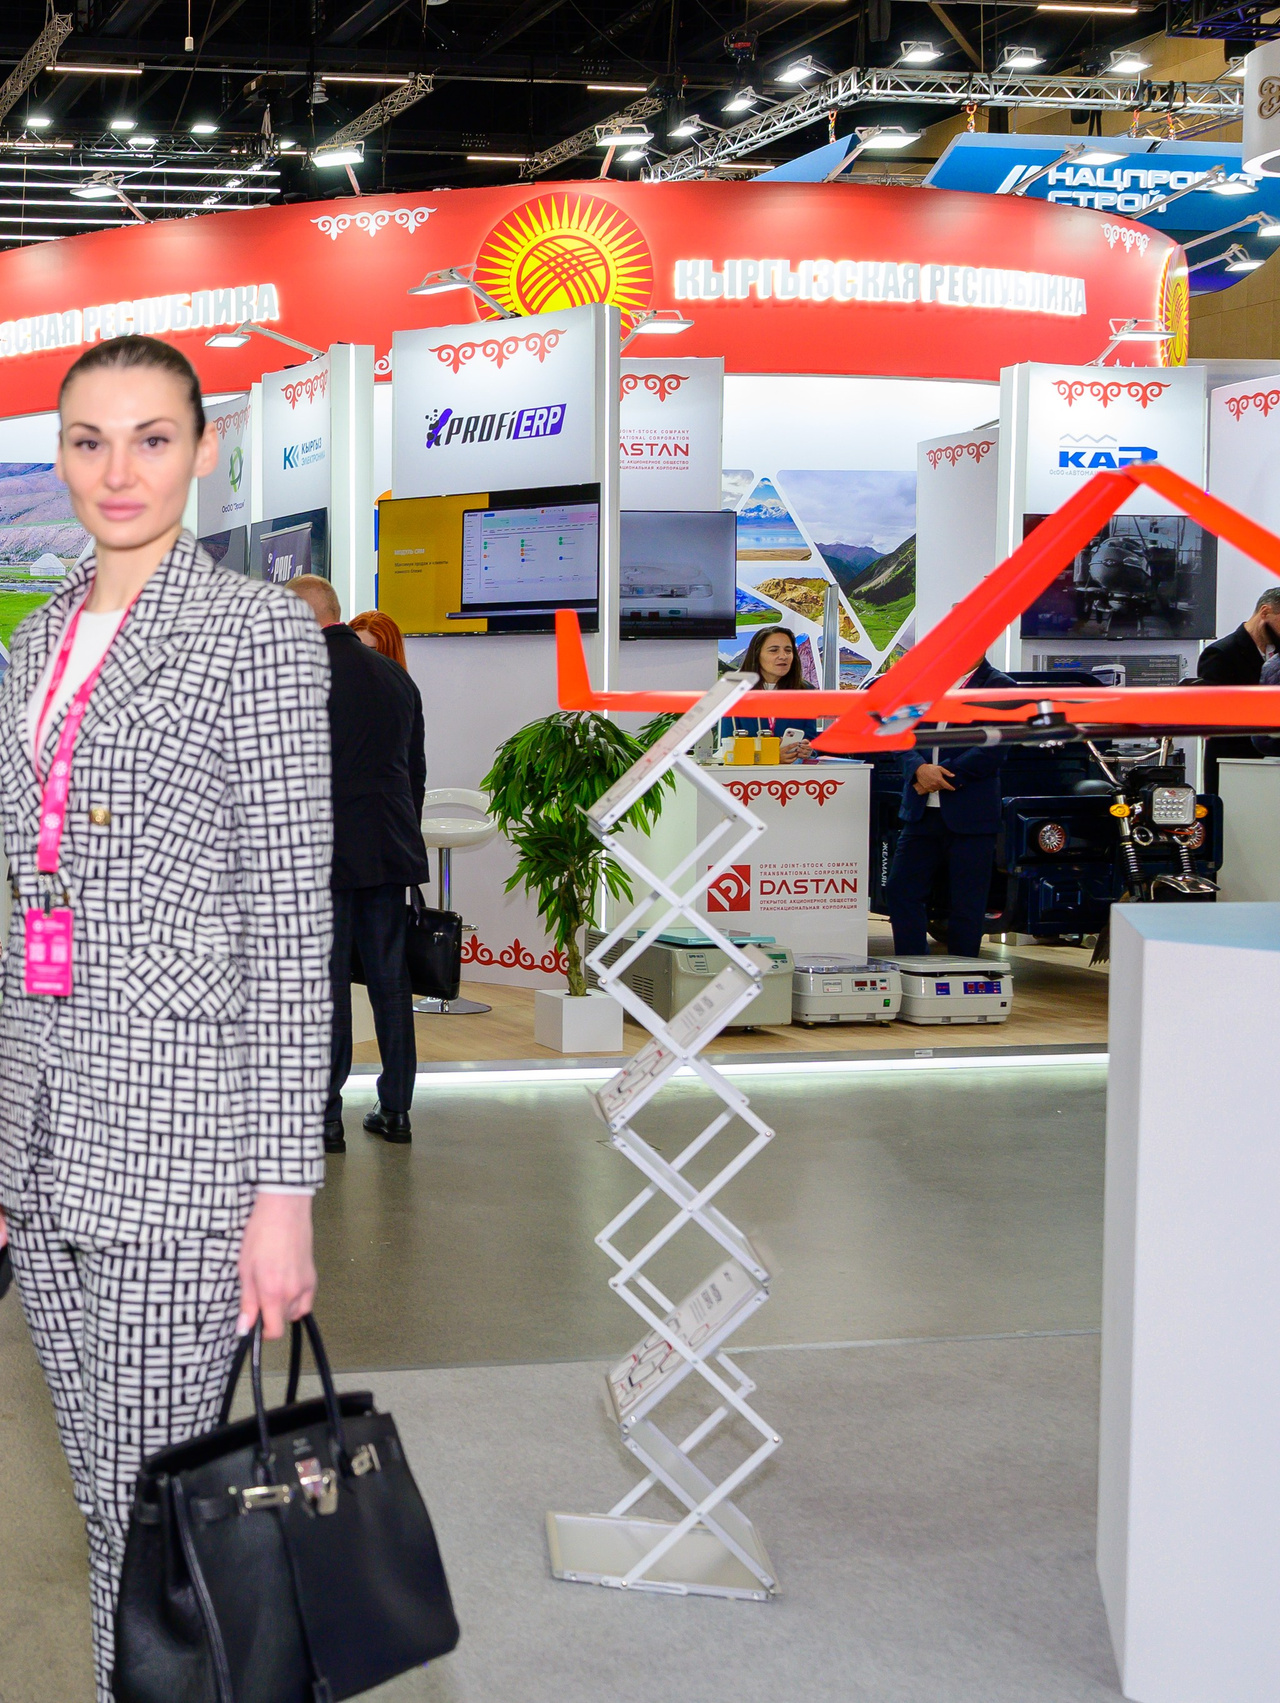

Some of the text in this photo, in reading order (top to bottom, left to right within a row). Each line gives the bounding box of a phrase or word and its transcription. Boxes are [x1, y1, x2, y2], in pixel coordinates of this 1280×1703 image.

[1047, 166, 1263, 193] НАЦПРОТ
[674, 259, 1087, 316] КЫРГЫЗСКАЯ РЕСПУБЛИКА
[83, 283, 280, 343] РЕСПУБЛИКА
[760, 878, 858, 895] DASTAN
